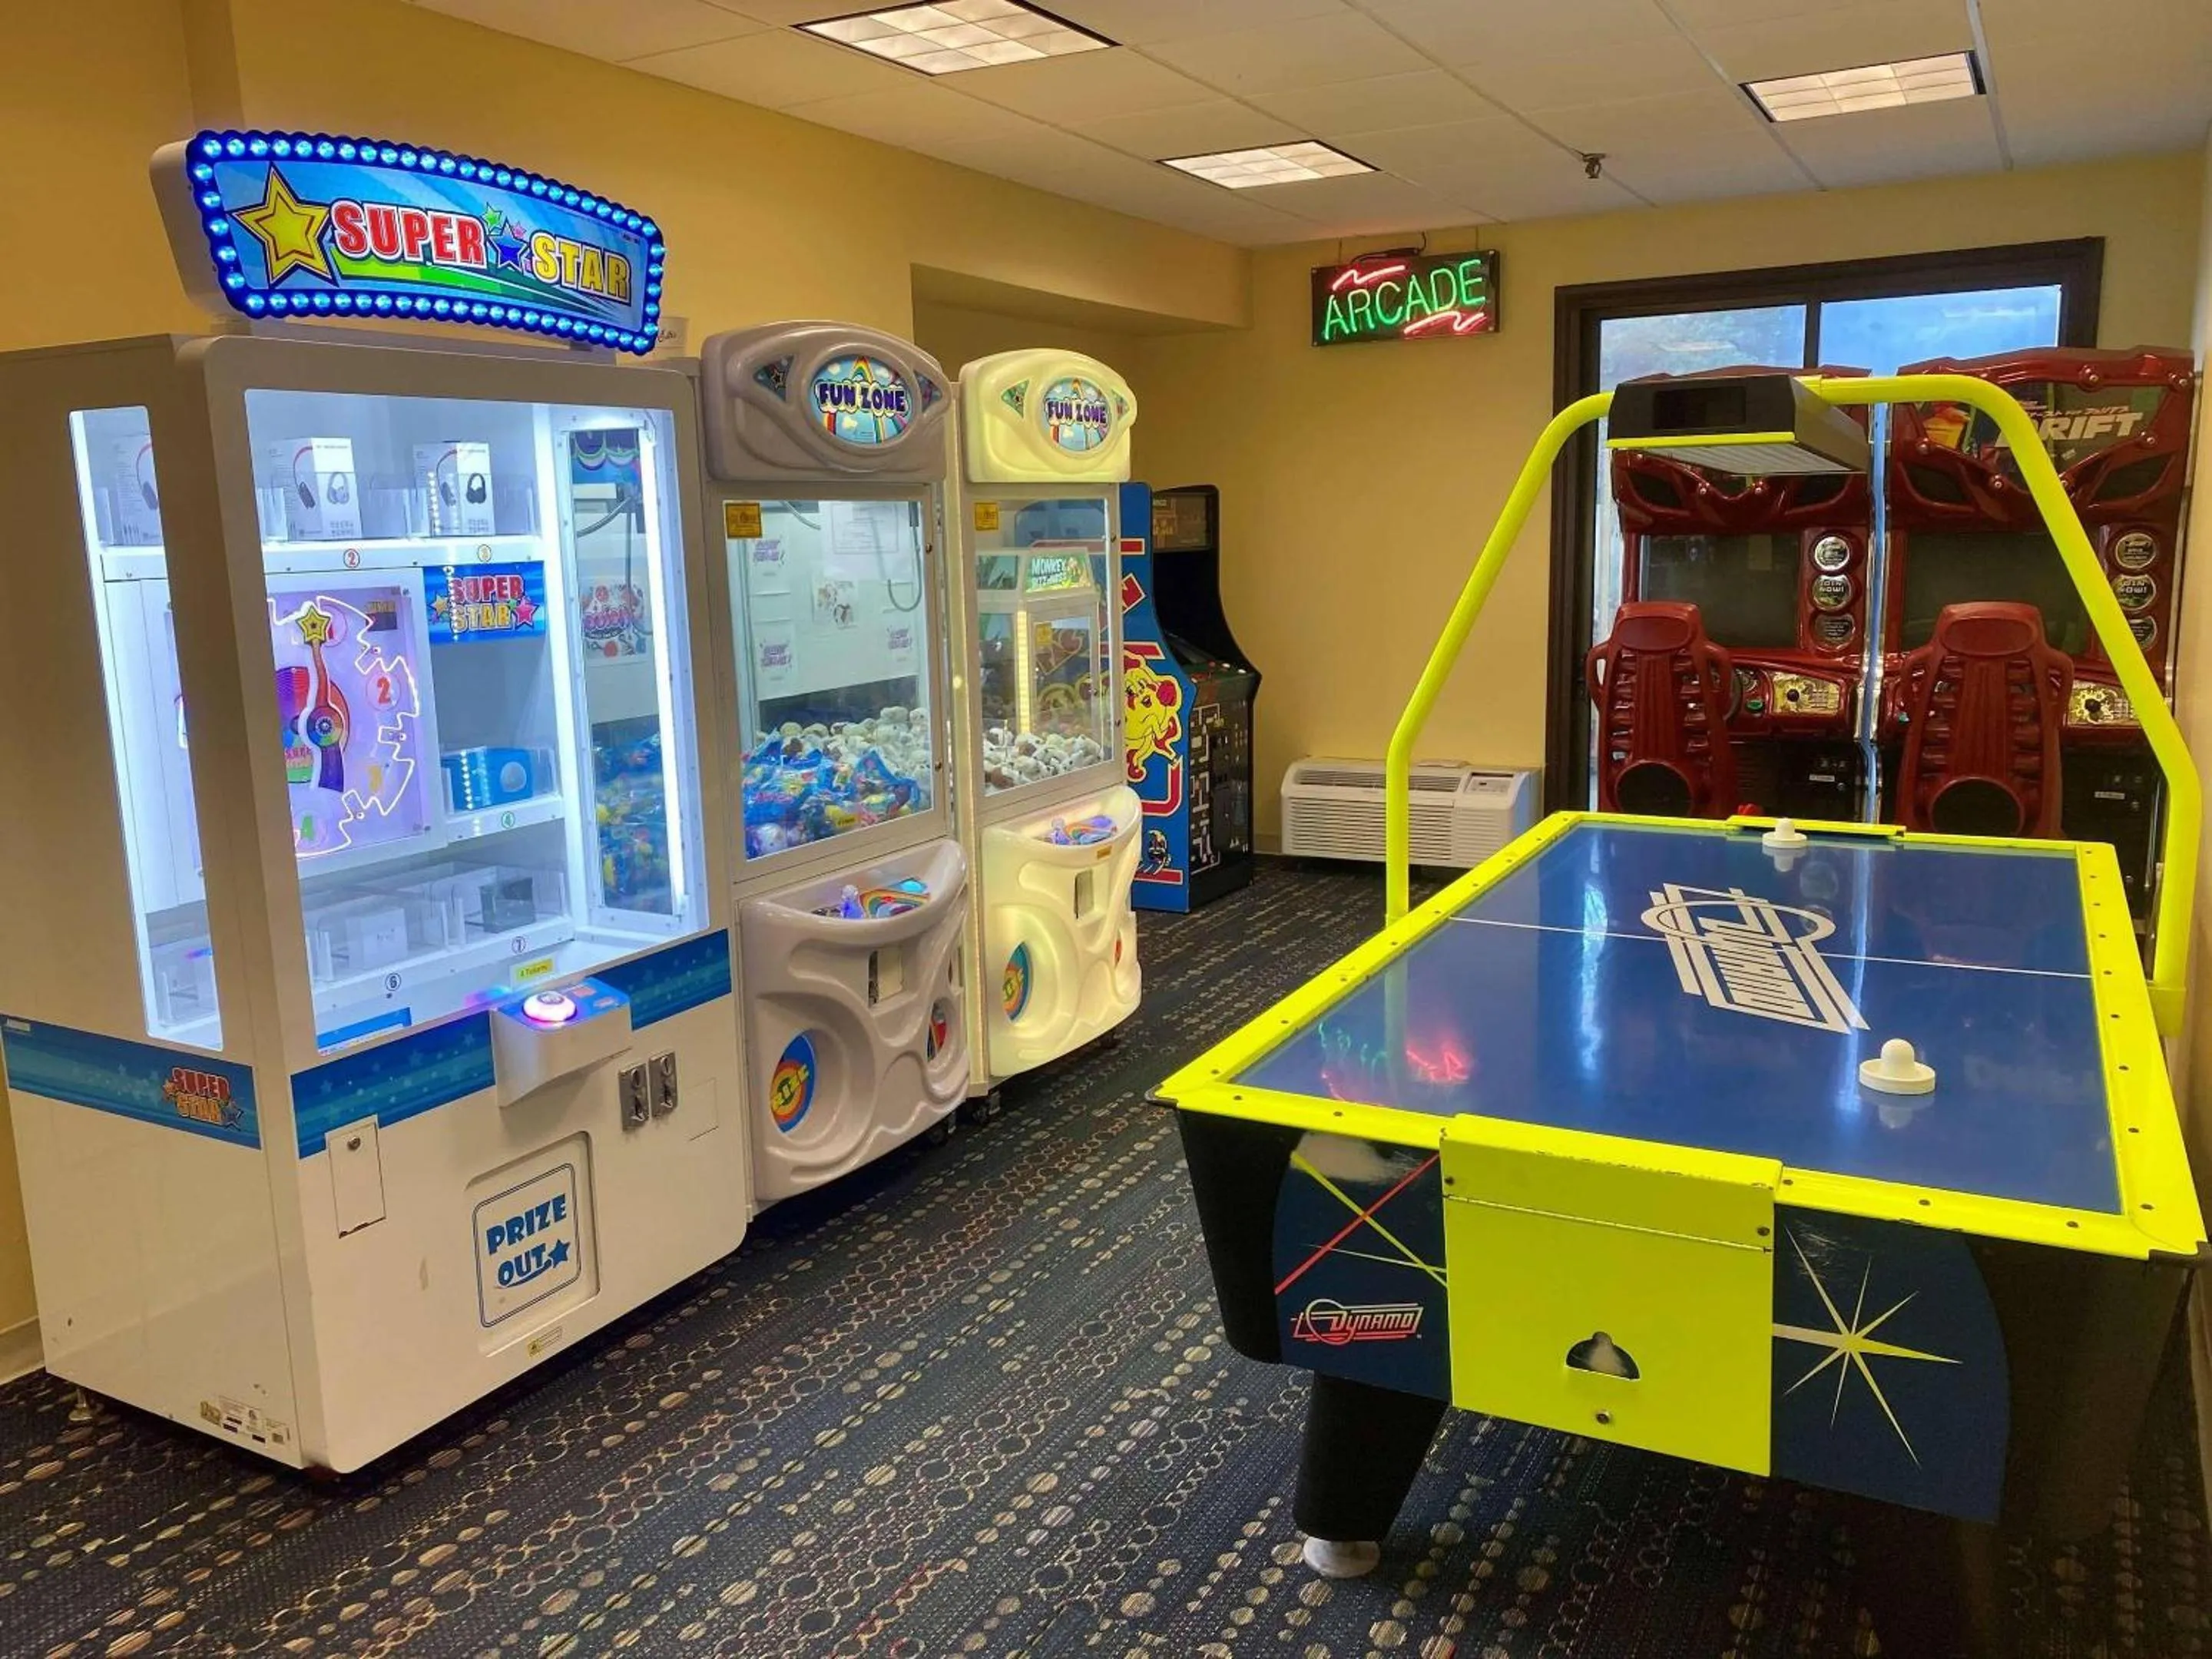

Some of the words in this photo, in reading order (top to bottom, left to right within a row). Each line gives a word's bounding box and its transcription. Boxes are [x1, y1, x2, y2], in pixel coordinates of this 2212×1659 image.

[329, 198, 489, 269] SUPER
[530, 230, 631, 306] STAR
[1323, 259, 1486, 340] ARCADE
[819, 382, 856, 407] FUN
[861, 386, 906, 412] ZONE
[1048, 400, 1073, 419] FUN
[1076, 403, 1106, 424] ZONE
[451, 575, 524, 603] SUPER
[451, 604, 512, 632] STAR
[376, 676, 392, 704] 2
[172, 1067, 230, 1101] SUPER
[175, 1092, 222, 1126] STAR
[485, 1193, 567, 1256] PRIZE
[497, 1242, 547, 1286] OUT
